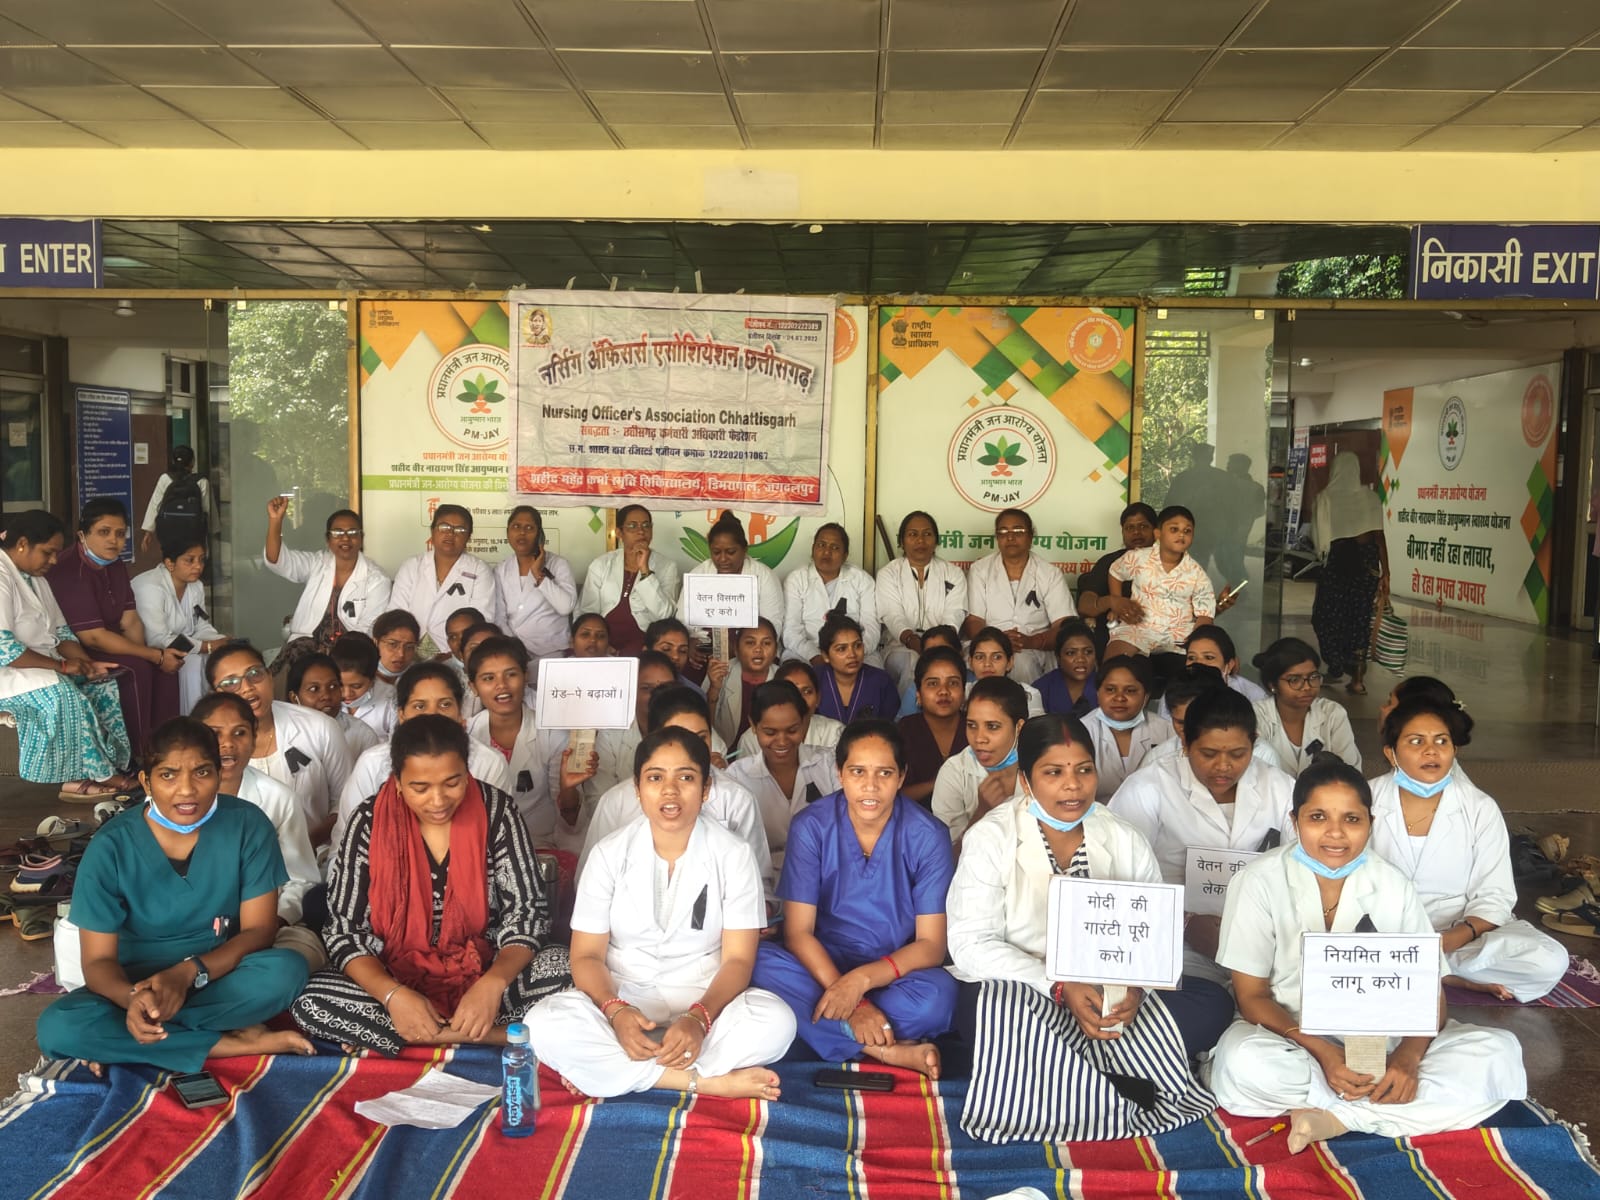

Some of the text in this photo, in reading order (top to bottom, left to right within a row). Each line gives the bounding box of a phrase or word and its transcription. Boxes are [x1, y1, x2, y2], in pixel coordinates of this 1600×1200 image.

[20, 243, 93, 274] ENTER
[1422, 237, 1596, 284] निकासी EXIT
[437, 356, 463, 399] प्रधानमंत्री
[462, 352, 480, 364] जन
[538, 347, 582, 385] नर्सिंग
[744, 344, 812, 393] छत्तीसगढ़
[542, 404, 797, 429] Nursing Officer's Association Chhattisgarh
[463, 428, 500, 440] PM-JAY
[691, 428, 726, 441] अधिकारी
[957, 414, 1048, 464] प्रधानमंत्री जन आरोग्य योजना
[983, 491, 1021, 503] PM-JAY
[968, 534, 996, 549] जन
[1055, 531, 1108, 550] योजना
[1407, 534, 1495, 574] बीमार नहीं रहा लाचार,
[696, 592, 713, 602] वेतन
[1412, 568, 1421, 593] हो
[1422, 575, 1434, 596] रहा
[1457, 580, 1486, 606] उपचार
[705, 608, 715, 617] दूर
[1196, 856, 1223, 872] वेतन
[1202, 880, 1228, 895] लेक
[1087, 891, 1148, 912] मोदी की
[1084, 919, 1150, 942] गारंटी पूरी
[1323, 945, 1419, 963] नियमित भर्ती
[1330, 975, 1366, 994] लागू
[509, 1077, 521, 1125] nayasa
